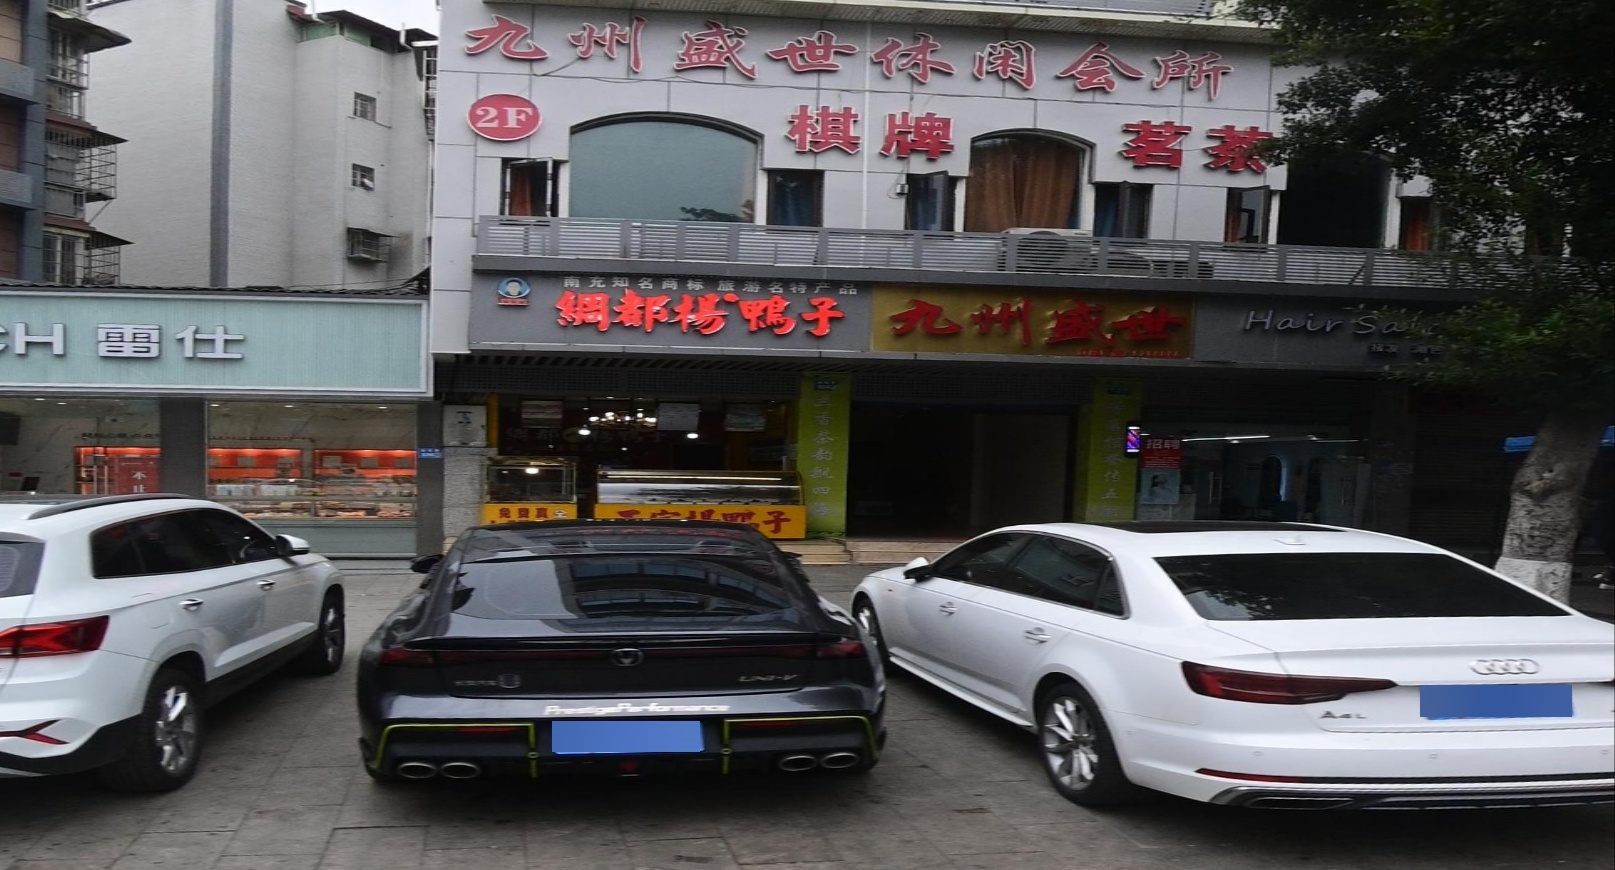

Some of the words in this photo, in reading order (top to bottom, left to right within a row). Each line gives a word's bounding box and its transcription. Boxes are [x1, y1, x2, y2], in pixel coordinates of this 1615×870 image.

[465, 14, 1233, 100] 九州盛世休闲会所
[474, 106, 533, 128] 2F
[785, 105, 954, 160] 棋牌
[1121, 119, 1273, 173] 茗茶
[563, 275, 704, 292] 南充知名商标
[717, 280, 858, 295] 旅游名特产品
[889, 298, 1186, 347] 九州盛世
[1245, 310, 1342, 332] Hair
[97, 323, 246, 359] 雷仕
[1145, 438, 1181, 449] 招聘
